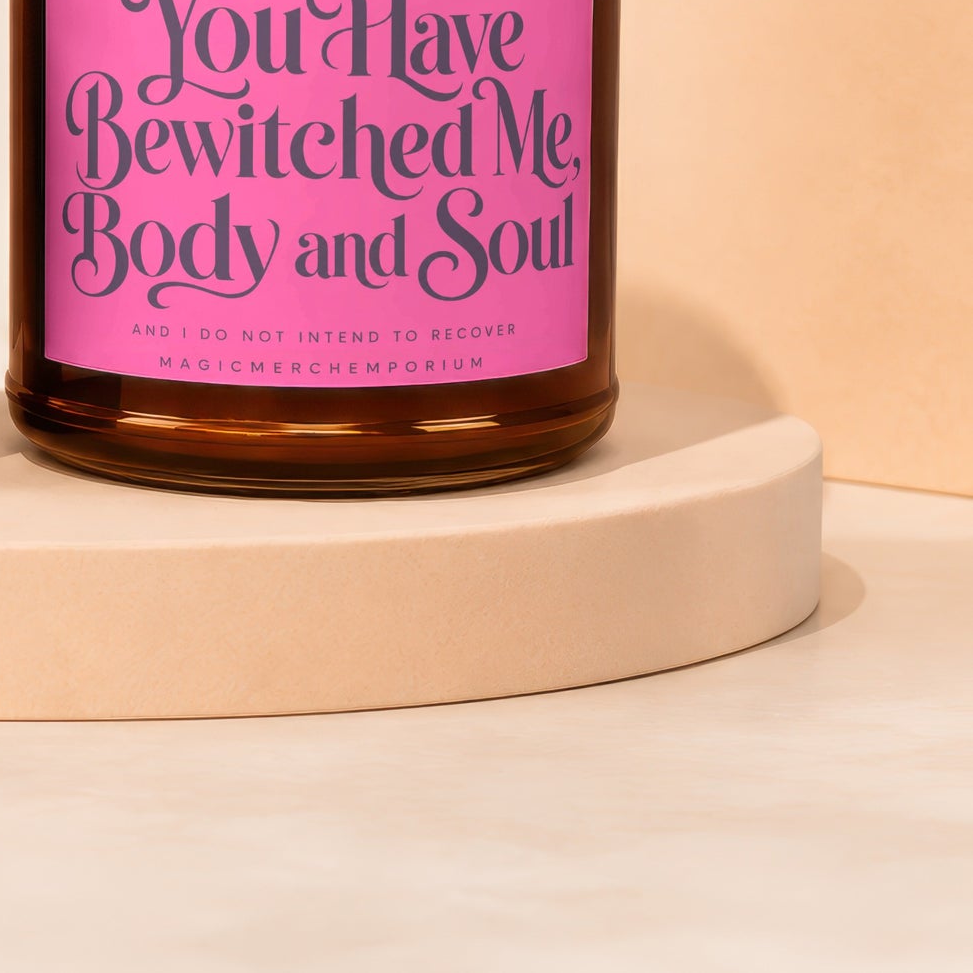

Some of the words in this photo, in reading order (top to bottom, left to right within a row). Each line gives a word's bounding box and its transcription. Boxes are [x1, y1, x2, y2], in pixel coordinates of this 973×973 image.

[64, 70, 475, 202] Bewitched
[471, 76, 582, 191] Me,
[61, 190, 281, 310] Body
[294, 213, 408, 290] and
[417, 186, 576, 302] Soul
[131, 323, 170, 339] AND
[181, 327, 187, 339] I
[199, 328, 229, 341] DO
[242, 330, 285, 343] NOT
[299, 330, 380, 344] INTEND
[393, 330, 419, 342] TO
[431, 323, 517, 341] RECOVER
[159, 355, 484, 375] MAGICMERCHEMPORIUM
